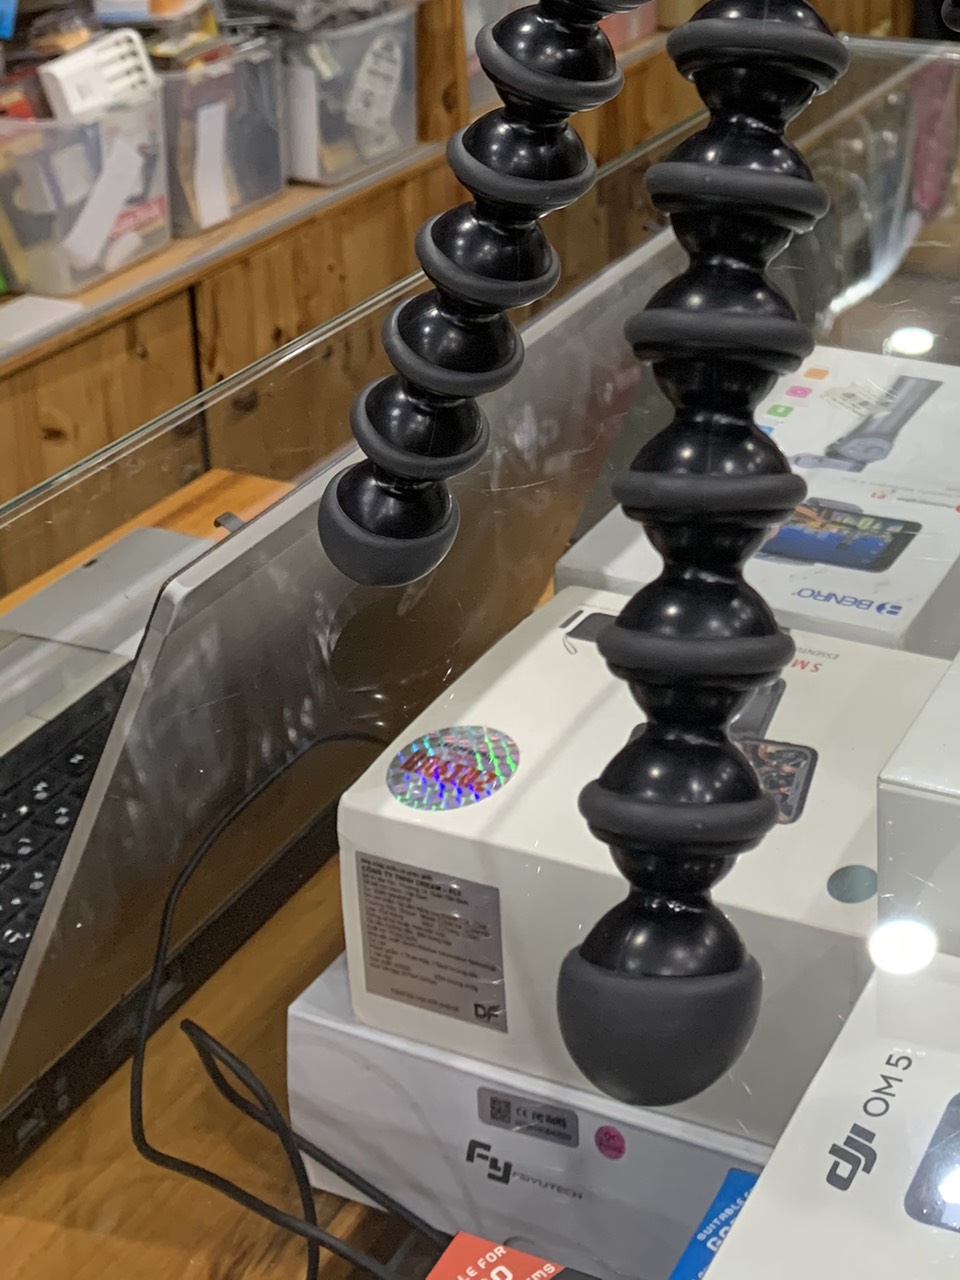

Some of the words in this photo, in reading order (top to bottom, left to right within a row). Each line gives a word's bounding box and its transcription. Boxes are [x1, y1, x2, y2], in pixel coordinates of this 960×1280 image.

[796, 587, 874, 611] BENRO
[863, 1074, 903, 1117] OM
[885, 1054, 912, 1071] 5
[477, 1245, 507, 1270] FOR
